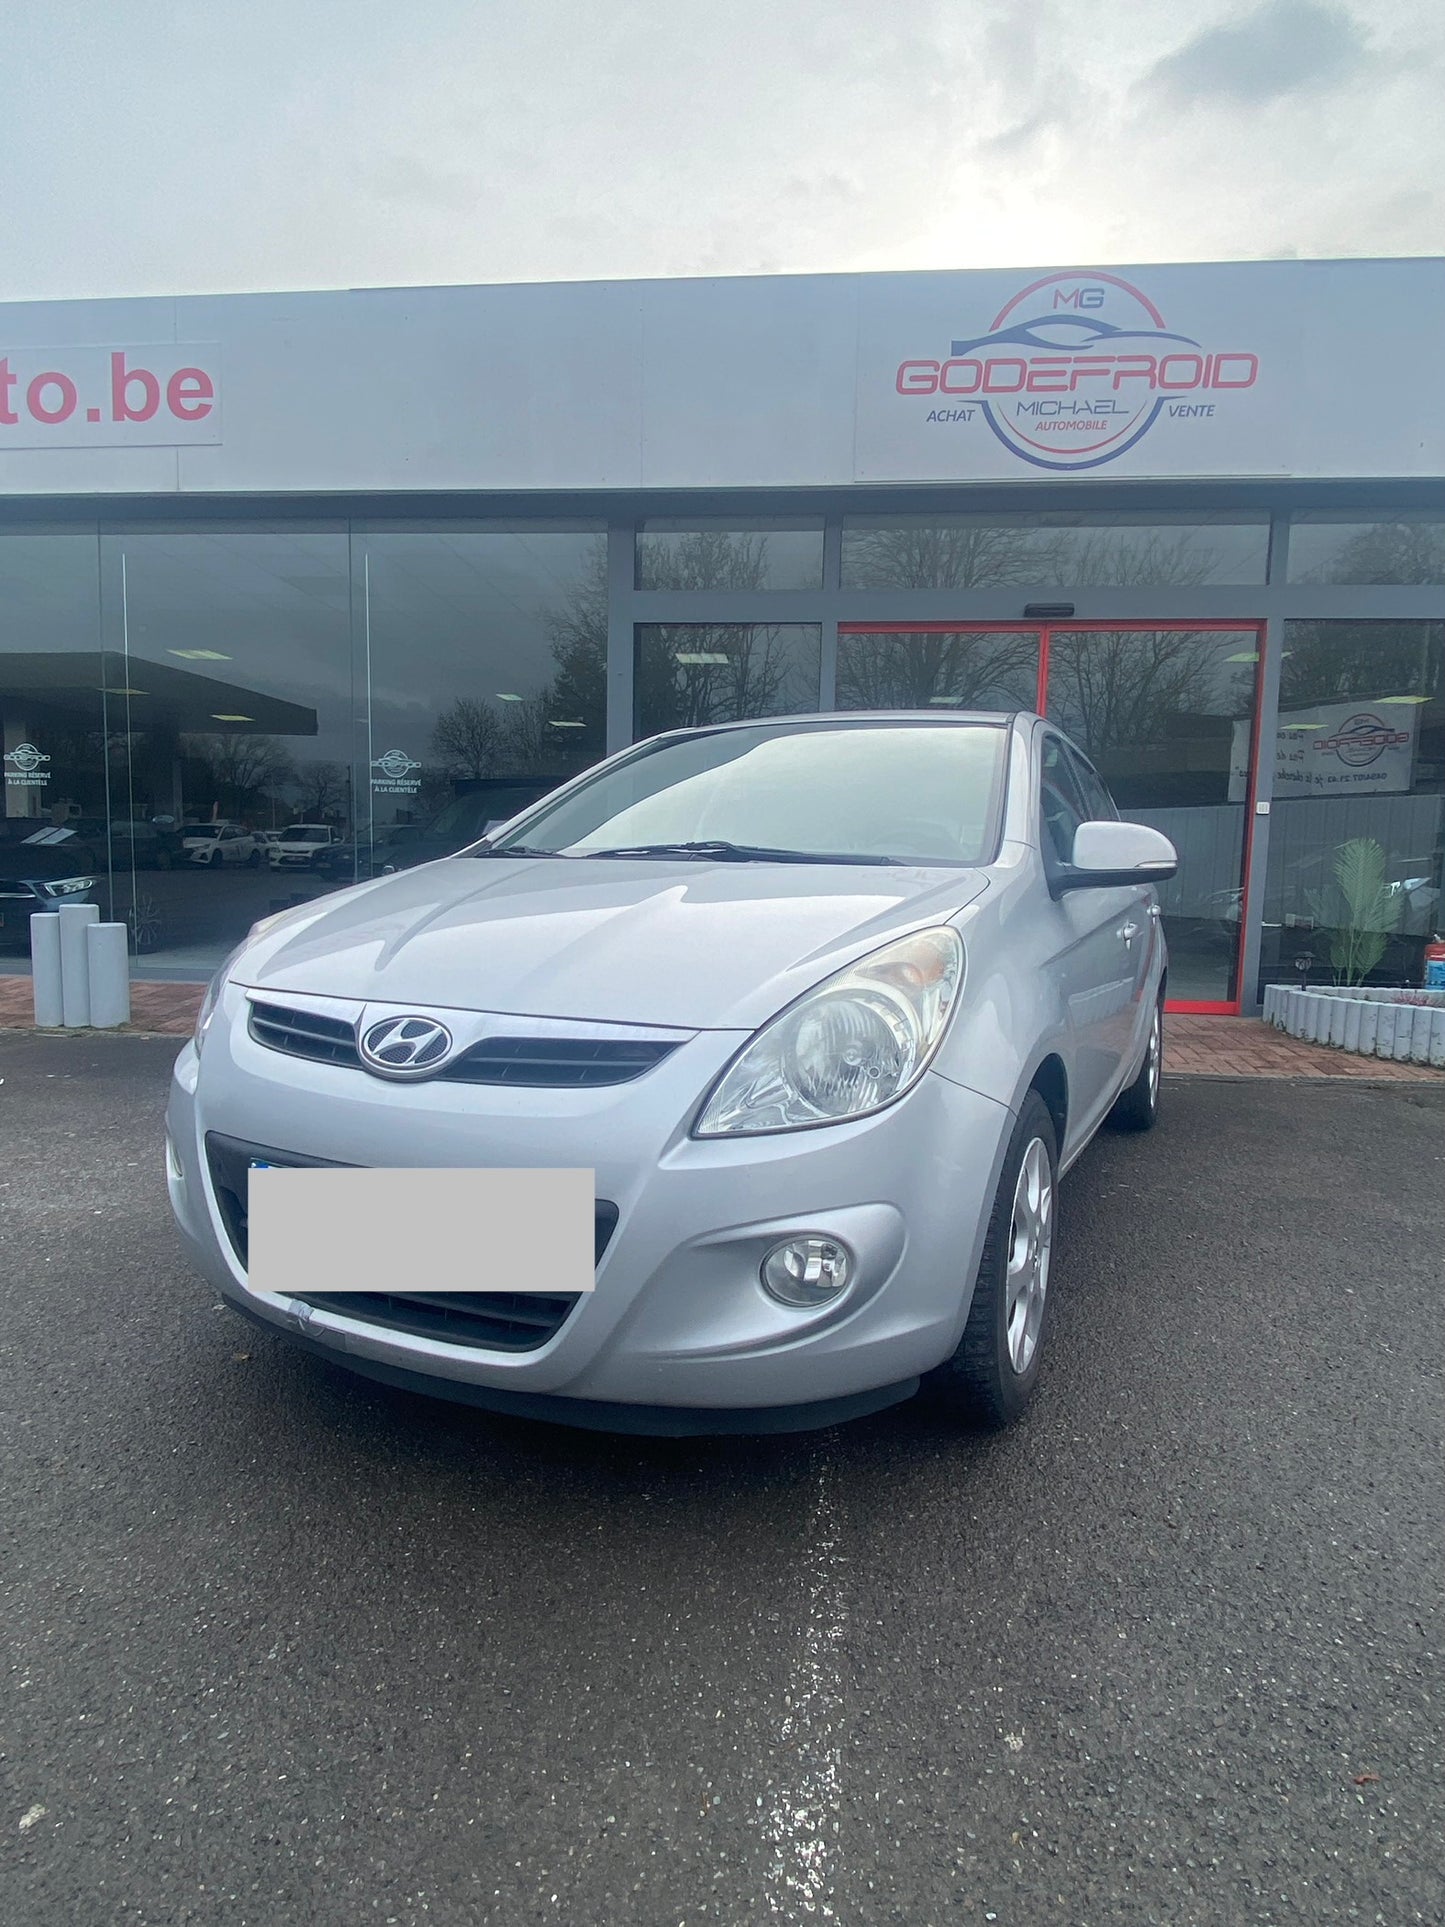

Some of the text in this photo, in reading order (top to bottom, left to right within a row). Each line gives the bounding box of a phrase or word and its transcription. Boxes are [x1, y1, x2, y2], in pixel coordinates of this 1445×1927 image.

[1053, 288, 1105, 309] MG
[896, 353, 1259, 395] GODEFROID
[926, 409, 976, 422] ACHAT
[1016, 400, 1130, 416] MICHAEL
[1168, 404, 1216, 418] VENTE
[1035, 420, 1108, 432] AUTOMOBILE
